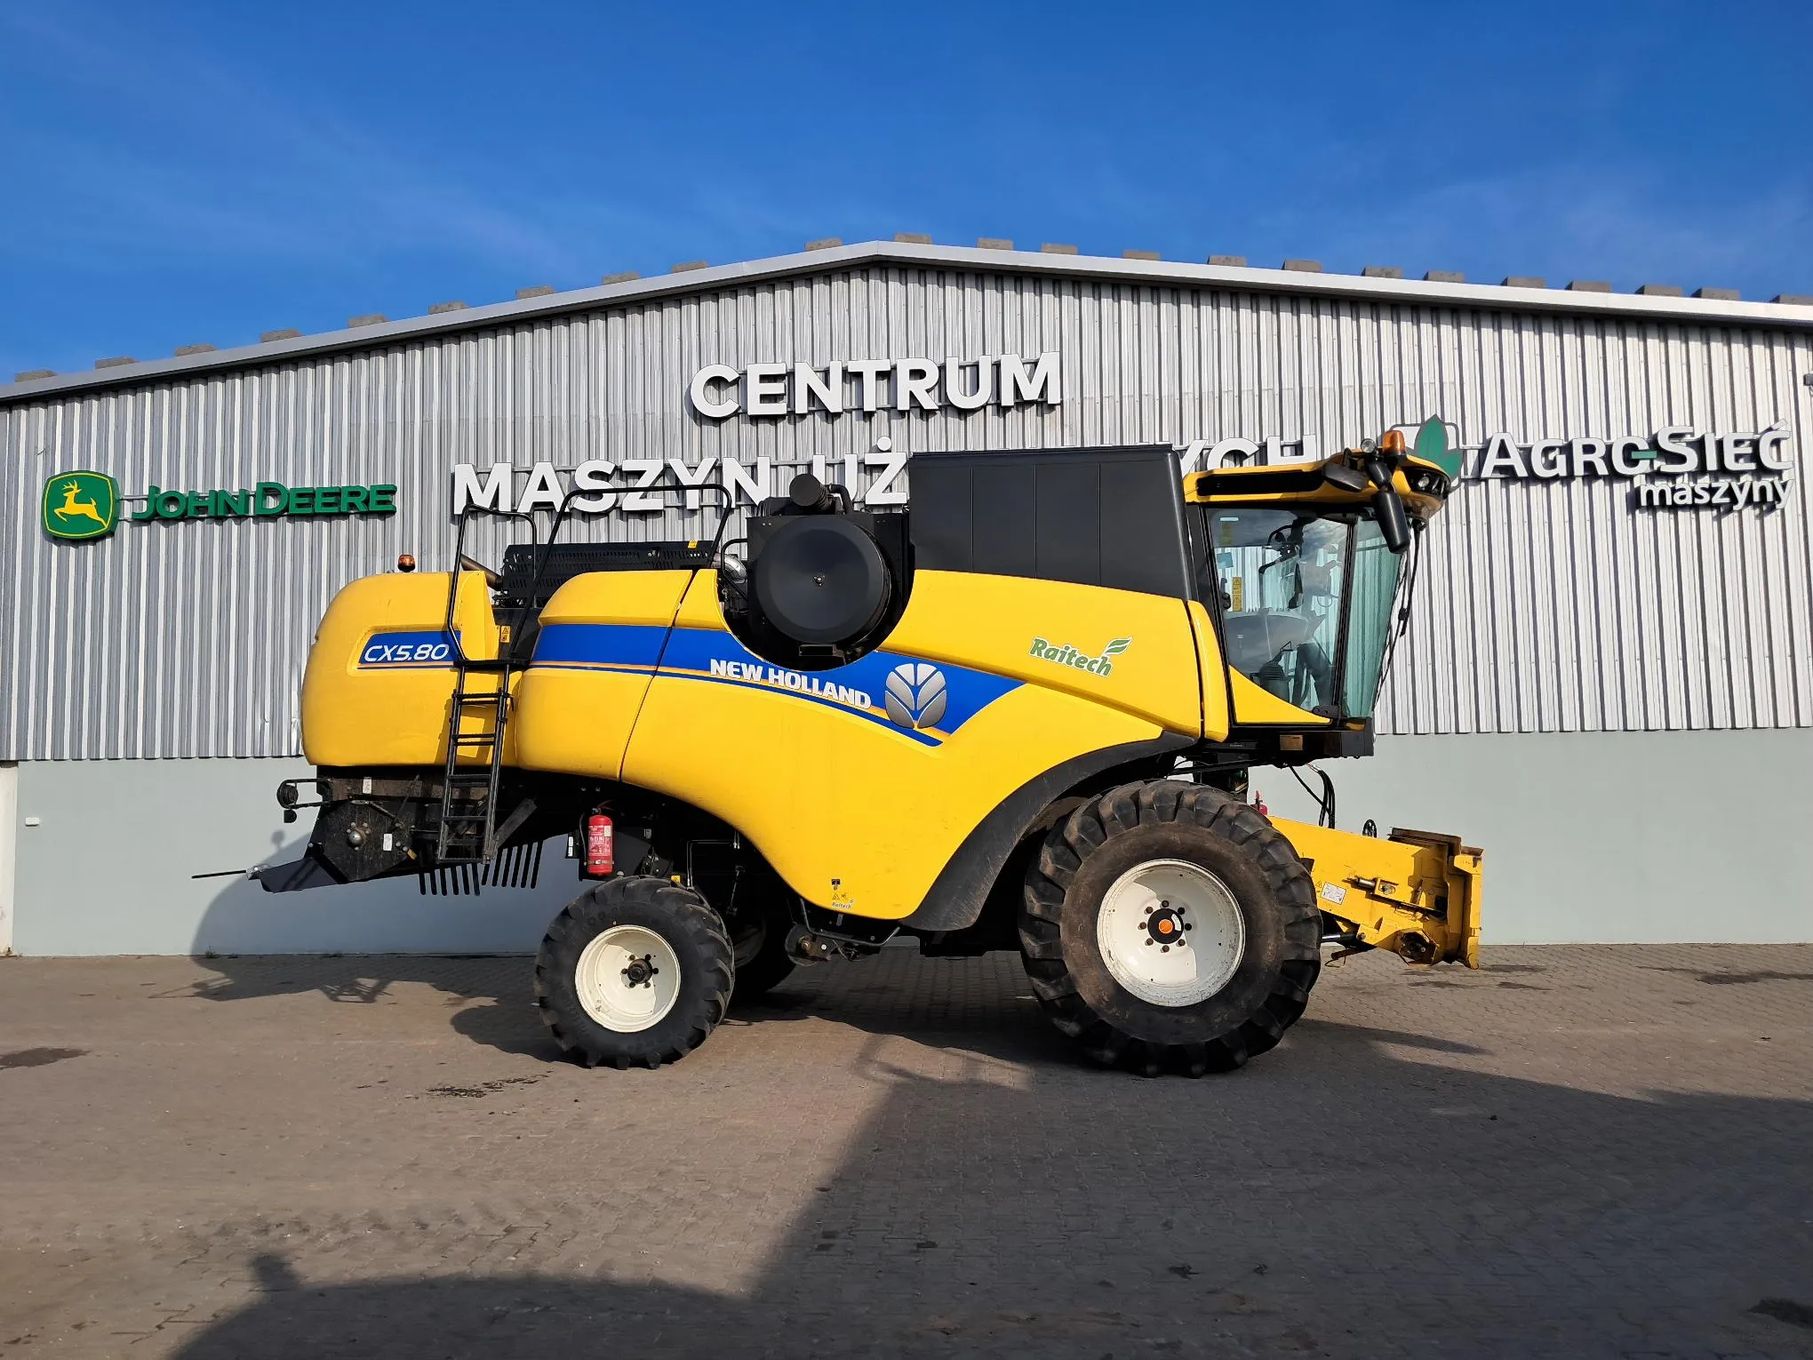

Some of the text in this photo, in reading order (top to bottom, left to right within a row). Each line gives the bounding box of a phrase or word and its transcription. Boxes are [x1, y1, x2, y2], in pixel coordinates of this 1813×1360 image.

[690, 352, 1061, 418] CENTRUM
[131, 481, 397, 519] JOHN DEERE
[453, 456, 771, 514] MASZYN
[1639, 479, 1794, 510] maszyny
[364, 643, 450, 662] CX5.80
[1029, 637, 1112, 676] Raitech
[710, 658, 872, 709] NEW HOLLAND
